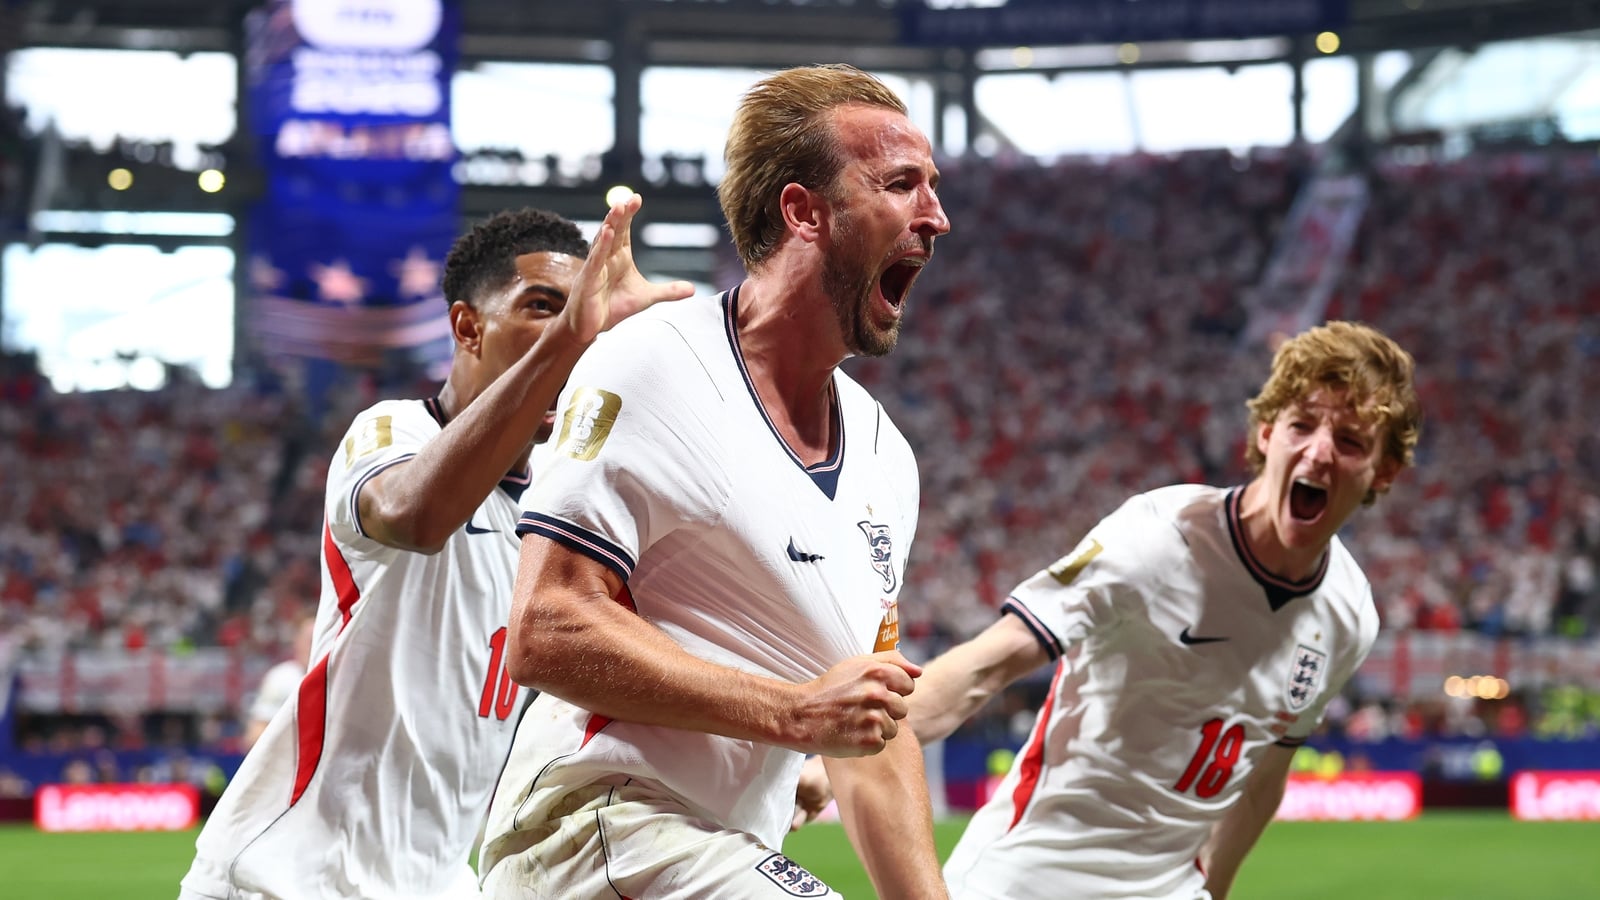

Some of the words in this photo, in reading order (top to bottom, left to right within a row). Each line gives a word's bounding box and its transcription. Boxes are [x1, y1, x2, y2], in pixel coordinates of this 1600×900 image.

[1173, 717, 1246, 799] 18
[40, 786, 193, 832] Lenovo
[1277, 780, 1415, 821] enovo
